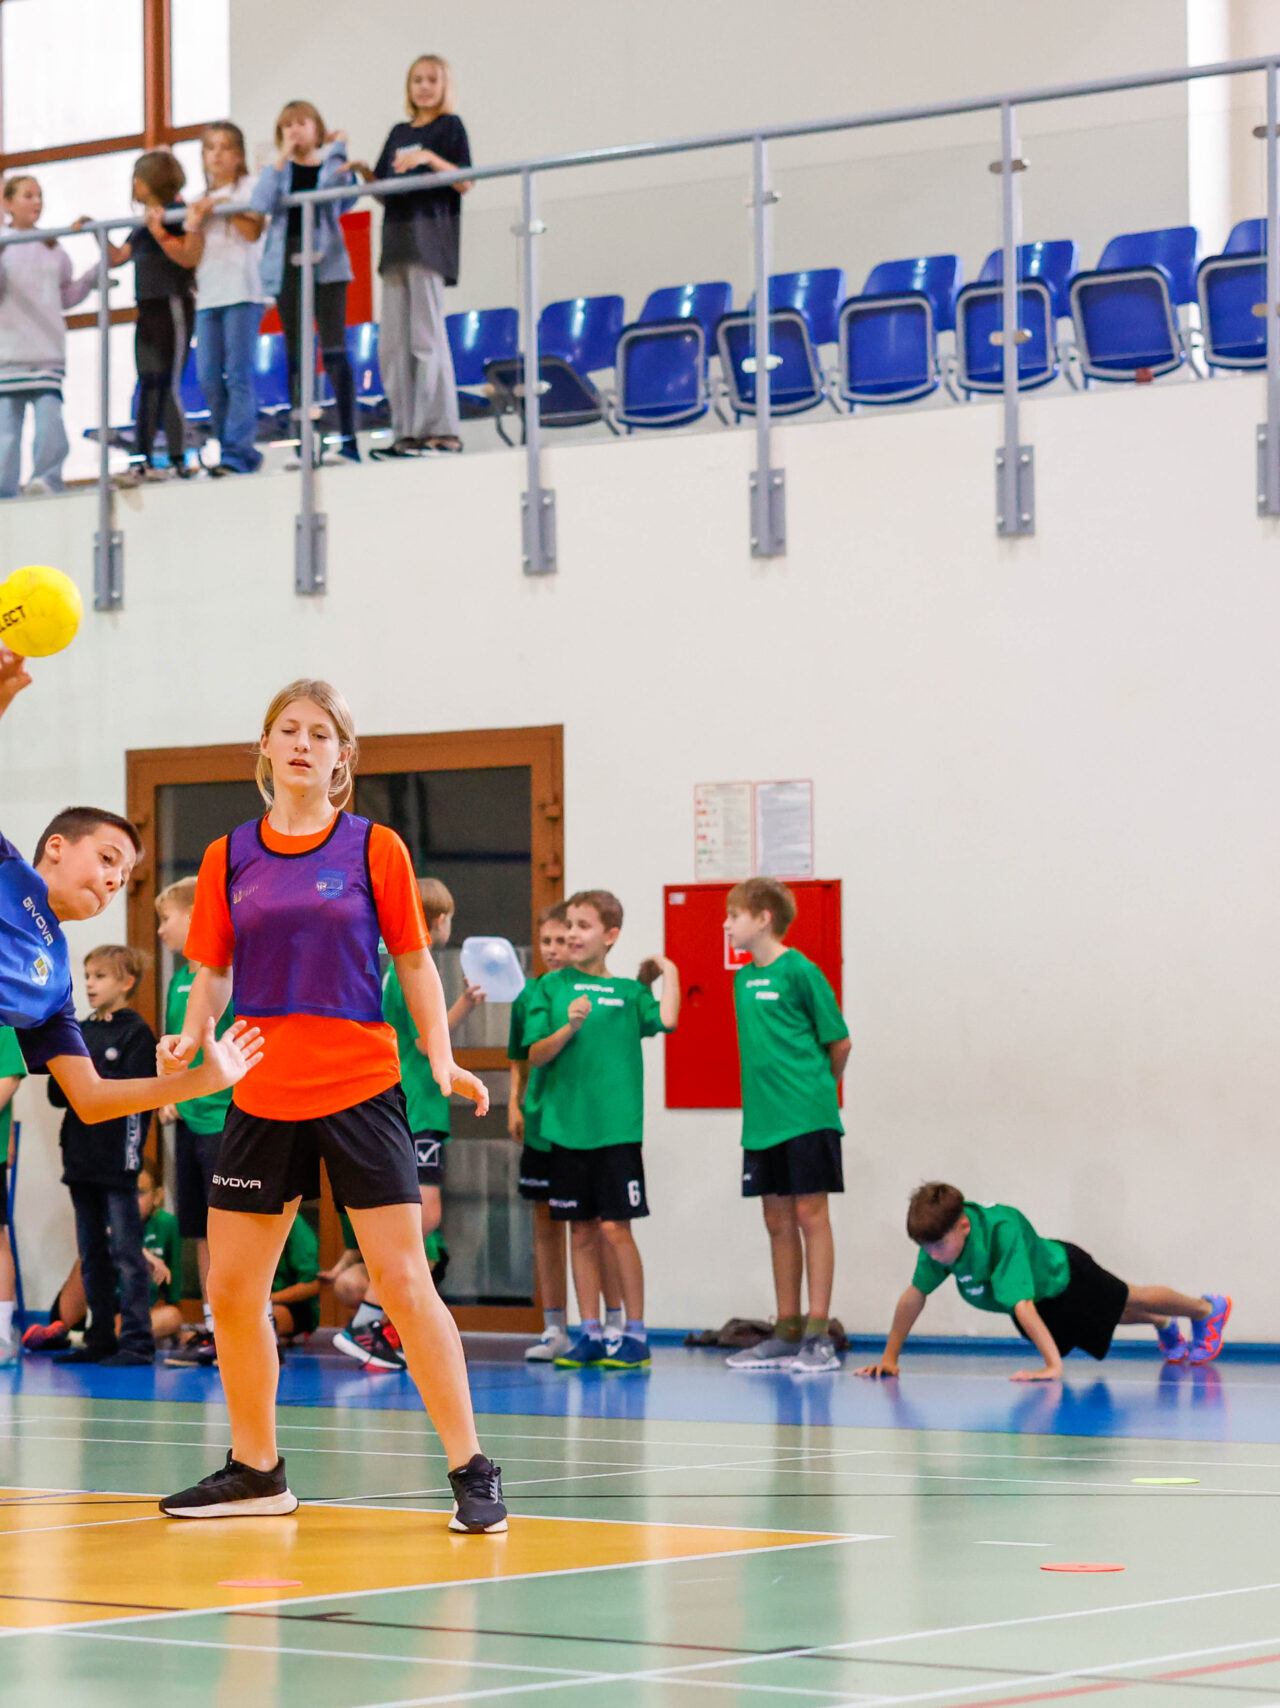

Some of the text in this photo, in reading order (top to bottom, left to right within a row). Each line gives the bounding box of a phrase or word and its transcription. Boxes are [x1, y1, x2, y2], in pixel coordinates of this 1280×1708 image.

[22, 896, 54, 947] GIVOVA
[212, 1174, 262, 1190] GIVOVA
[627, 1180, 641, 1207] 6
